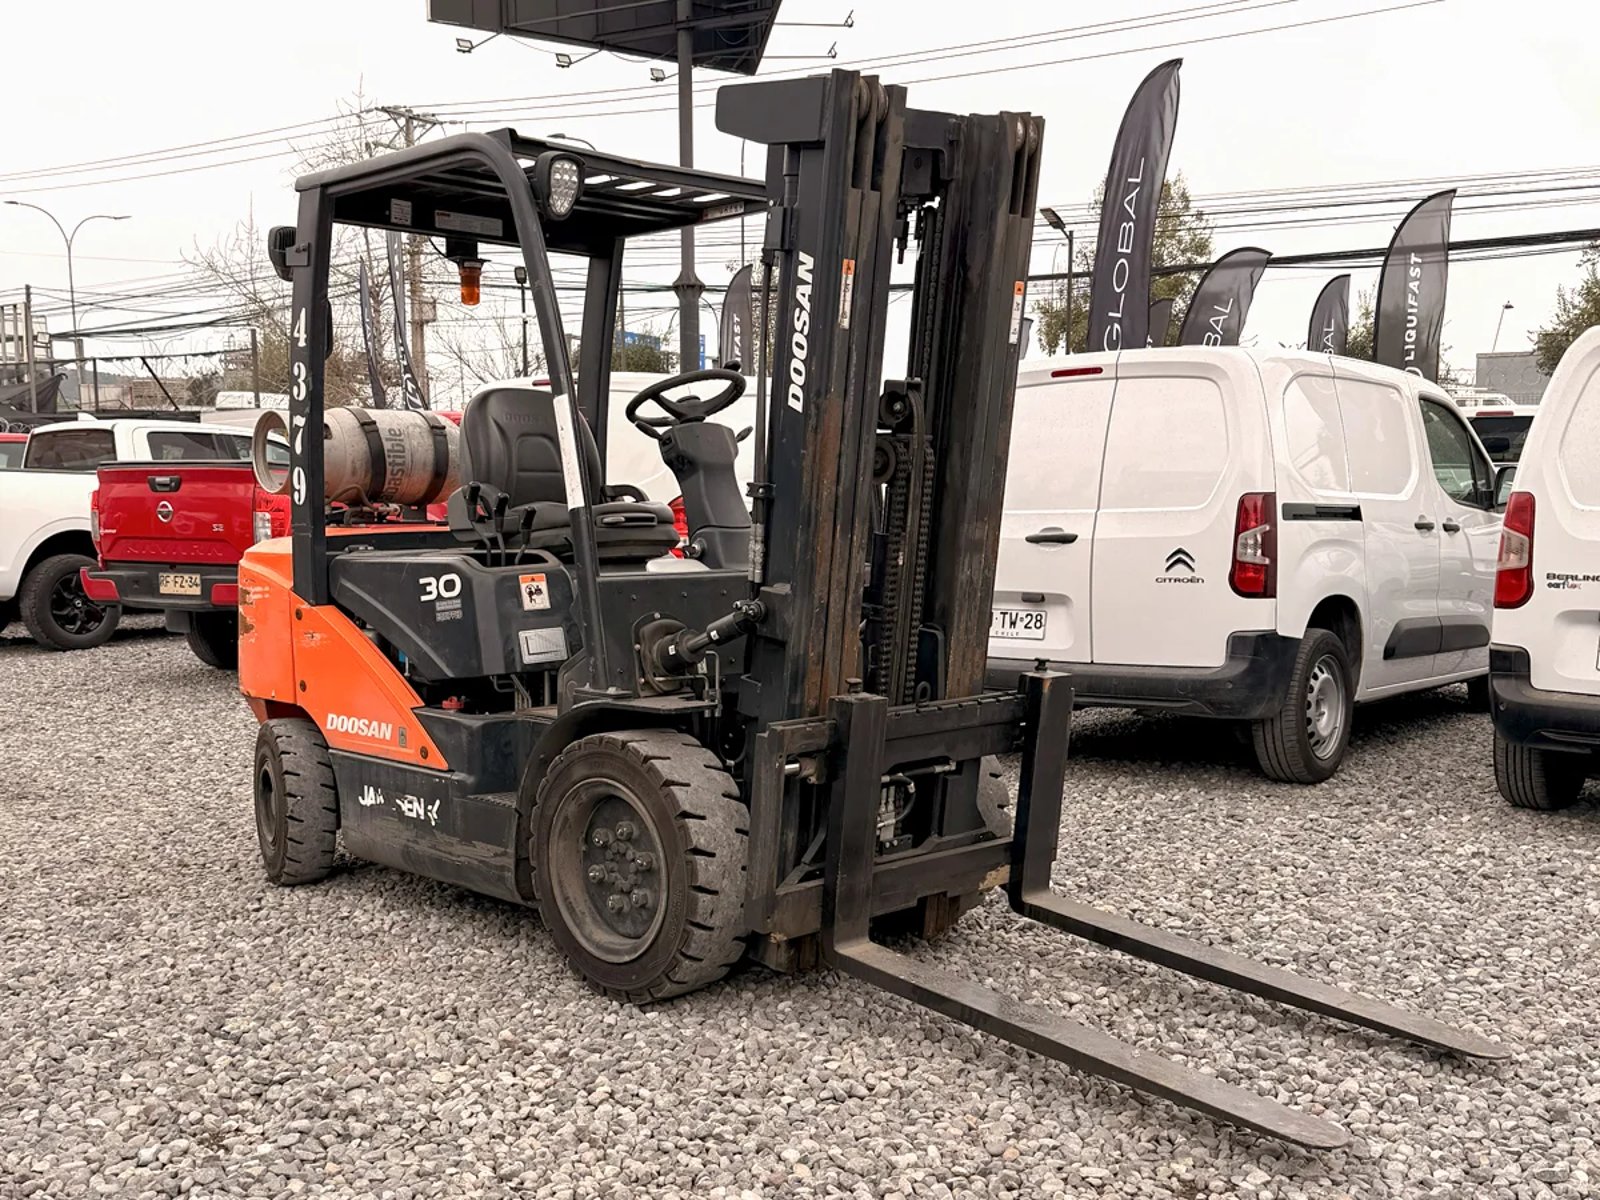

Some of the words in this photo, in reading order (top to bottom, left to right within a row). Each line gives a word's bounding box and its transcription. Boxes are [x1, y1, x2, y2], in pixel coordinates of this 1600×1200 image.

[1103, 157, 1145, 352] GLOBAL
[1404, 252, 1422, 362] LIQUIFAST
[787, 251, 815, 413] DOOSAN
[292, 307, 308, 505] 4379
[418, 573, 462, 602] 30
[326, 713, 393, 740] DOOSAN
